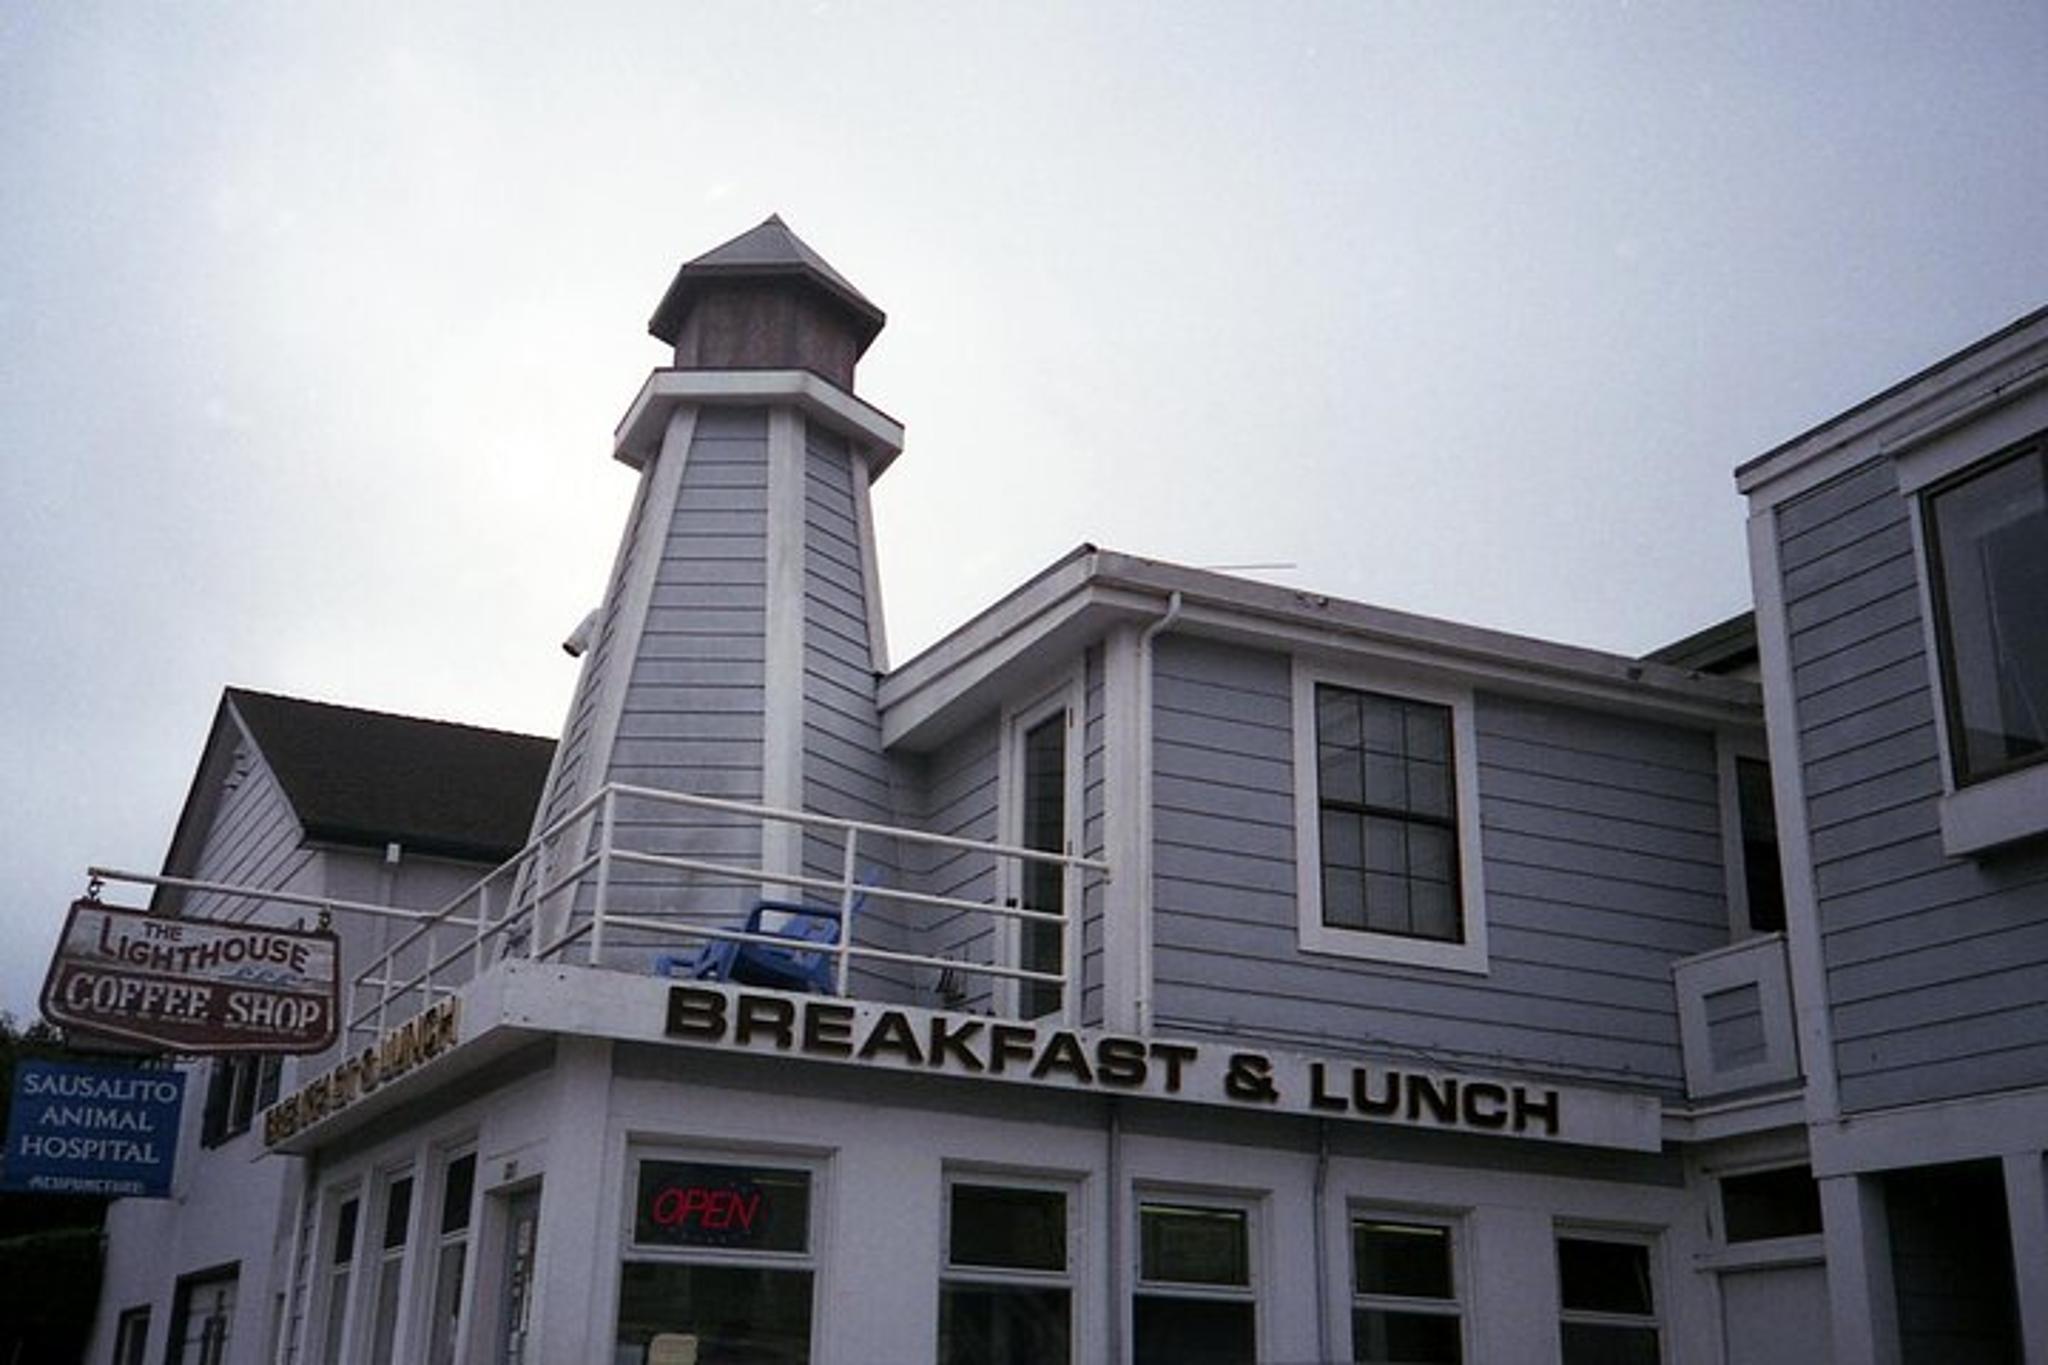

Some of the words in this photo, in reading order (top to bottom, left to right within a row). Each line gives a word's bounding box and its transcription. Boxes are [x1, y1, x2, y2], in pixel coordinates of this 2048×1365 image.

[99, 915, 311, 974] LIGHTHOUSE
[143, 921, 183, 942] THE
[65, 971, 211, 1018] COFFEE
[226, 989, 321, 1034] SHOP
[665, 985, 1198, 1093] BREAKFAST
[1225, 1052, 1279, 1103] &
[1309, 1061, 1560, 1137] LUNCH
[23, 1073, 178, 1104] SAUSALITO
[39, 1105, 156, 1133] ANIMAL
[20, 1134, 161, 1165] HOSPITAL
[653, 1187, 761, 1230] OPEN
